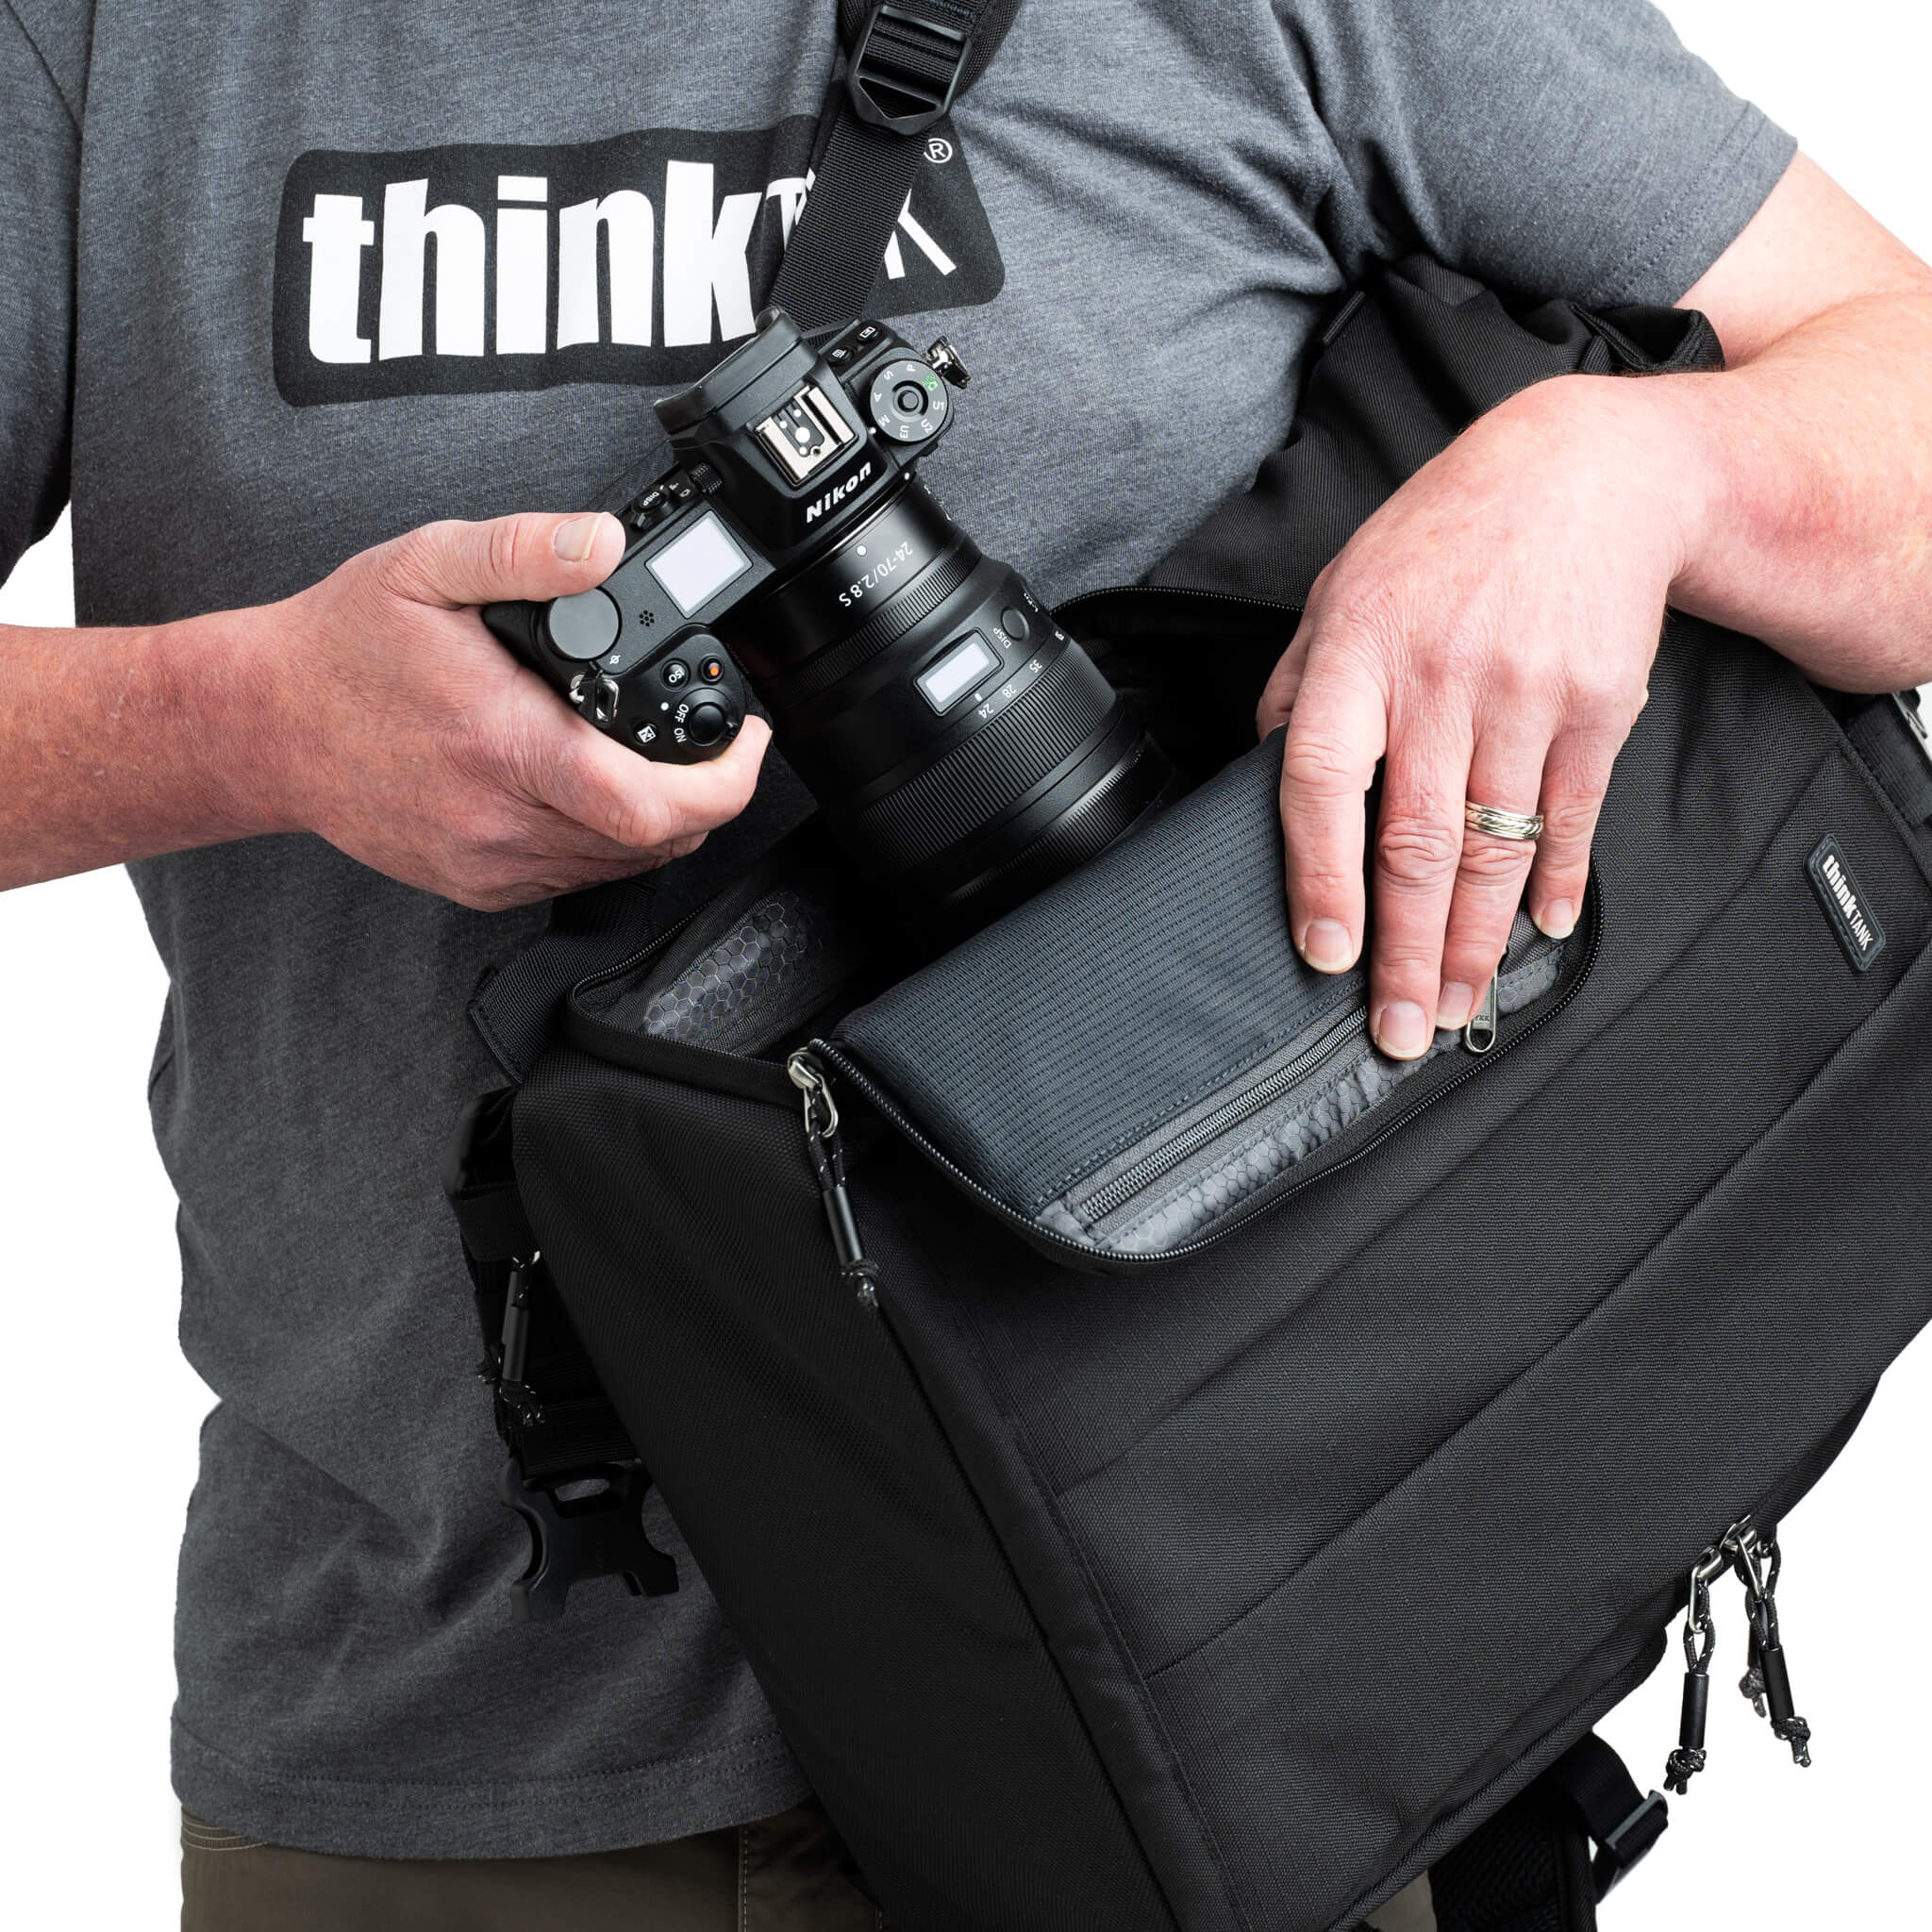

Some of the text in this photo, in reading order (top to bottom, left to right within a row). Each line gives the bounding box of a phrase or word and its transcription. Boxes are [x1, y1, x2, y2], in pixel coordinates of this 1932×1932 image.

[806, 461, 872, 524] Nikon
[839, 541, 914, 607] 24-70/2.8 S
[992, 627, 1012, 649] DISP
[1028, 659, 1042, 674] 35
[669, 669, 685, 683] ISO
[1002, 684, 1017, 698] 28
[675, 703, 690, 724] OFF
[978, 703, 994, 719] 24
[674, 727, 687, 743] ON
